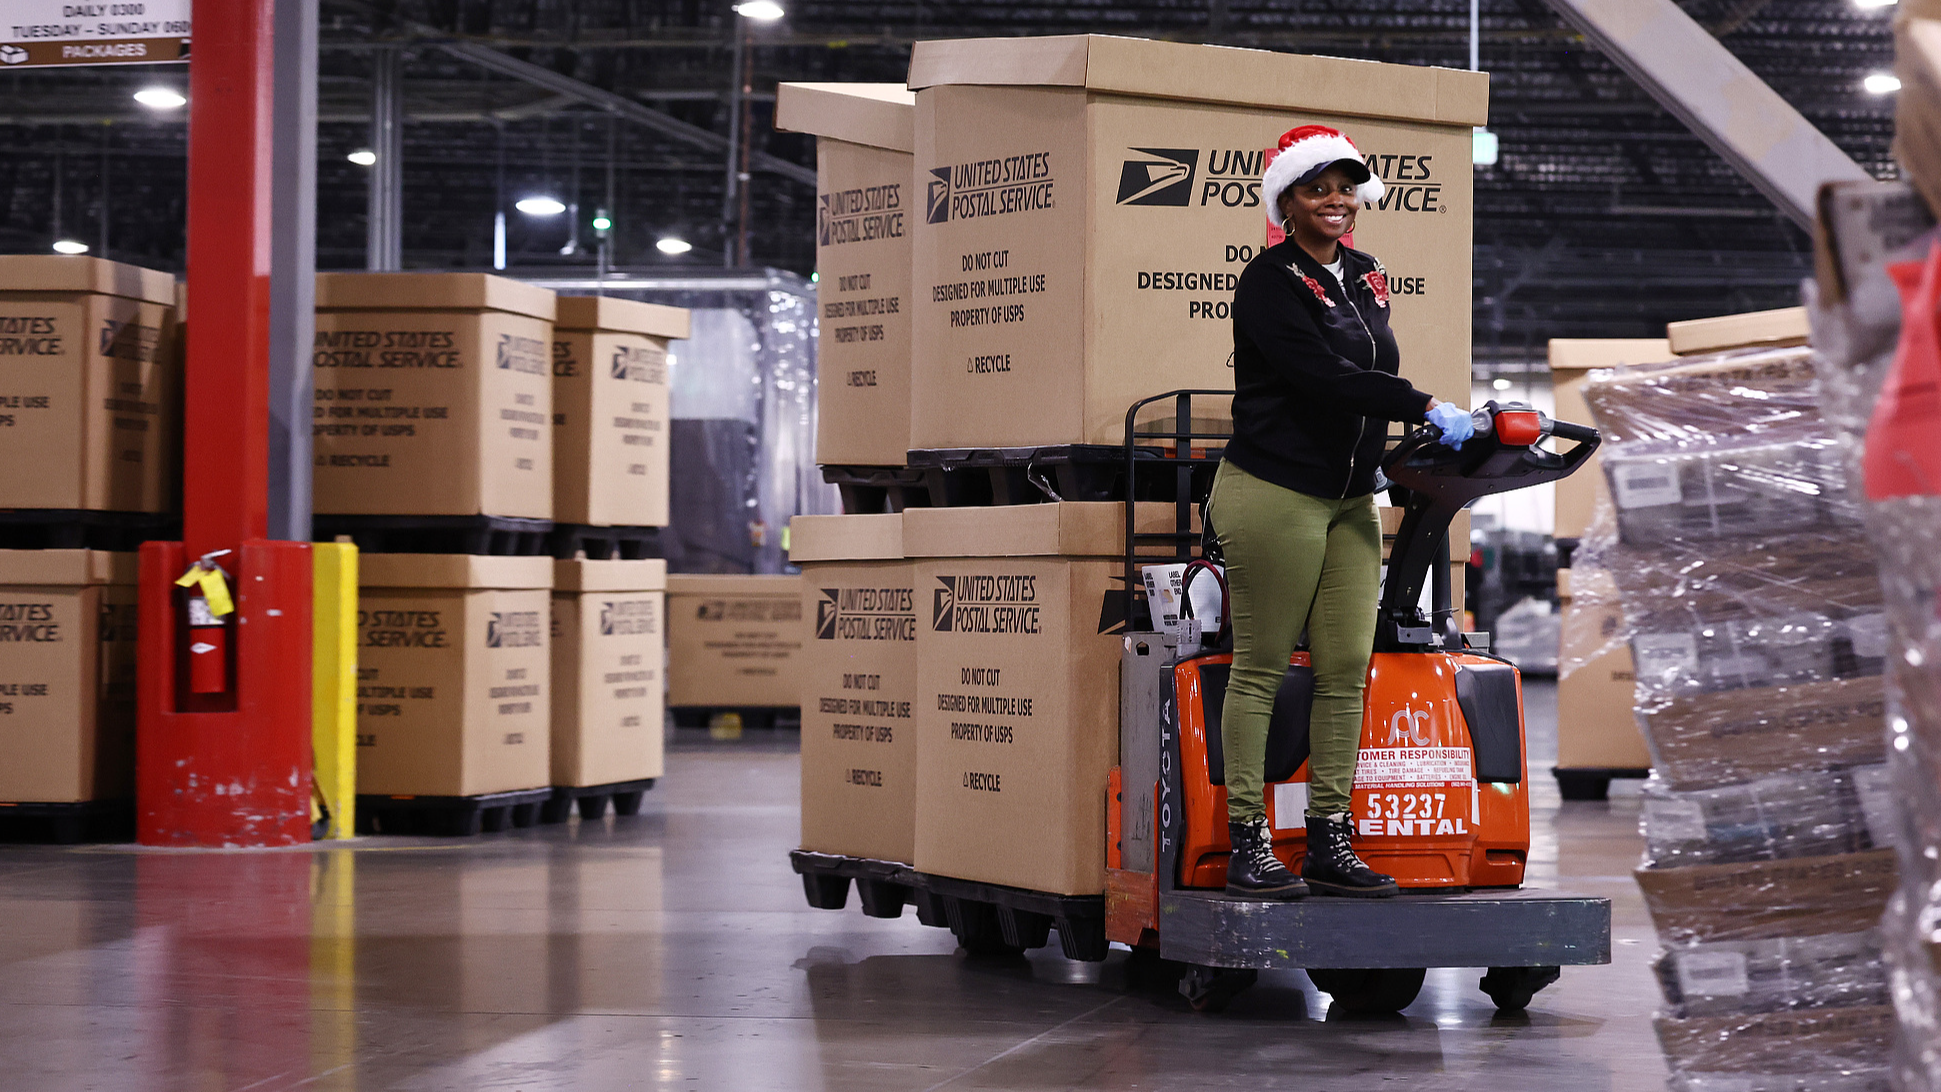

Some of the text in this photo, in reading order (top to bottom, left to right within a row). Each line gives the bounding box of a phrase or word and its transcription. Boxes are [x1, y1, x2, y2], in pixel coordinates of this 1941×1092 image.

[63, 3, 145, 17] DAILY 0300
[12, 24, 82, 37] TUESDAY
[97, 22, 160, 35] SUNDAY
[163, 21, 191, 33] 060
[62, 43, 147, 58] PACKAGES
[954, 152, 1050, 189] UNITED STATES
[1208, 149, 1432, 180] UNI ATES
[832, 184, 900, 217] UNITED STATES
[952, 183, 1054, 220] POSTAL SERVICE
[1201, 182, 1261, 207] POS
[832, 213, 904, 244] POSTAL SERVICE
[962, 250, 1009, 272] DO NOT CUT
[1225, 245, 1253, 263] DO
[933, 274, 1046, 302] DESIGNED FOR MULTIPLE USE
[1137, 271, 1426, 295] DESIGNED USE
[886, 297, 899, 313] USE
[1189, 301, 1234, 319] PRO
[951, 304, 1025, 327] PROPERTY OF USPS
[384, 331, 454, 348] STATES
[313, 351, 458, 368] OSTAL SERVICE
[975, 354, 1011, 373] RECYCLE
[23, 396, 50, 408] USE
[957, 575, 1036, 602] UNITED STATES
[840, 588, 913, 611] UNITED STATES
[371, 610, 440, 627] STATES
[955, 606, 1040, 634] POSTAL SERVICE
[366, 630, 446, 648] SERVICE
[838, 618, 916, 641] POSTAL SERVICE
[961, 668, 1000, 686] DO NOT CUT
[21, 684, 47, 696] USE
[862, 700, 895, 718] MULTIPLE
[896, 701, 911, 718] USE
[938, 694, 1033, 716] DESIGNED FOR MULTIPLE USE
[833, 723, 893, 743] PROPERTY OF USPS
[951, 722, 1013, 744] PROPERTY OF USPS
[1400, 749, 1469, 760] RESPONSIBILITY
[852, 769, 882, 787] RECYCLE
[970, 772, 1001, 792] RECYCLE
[1161, 698, 1172, 852] TOYOTA
[1374, 774, 1406, 782] EQUIPMENT
[1367, 793, 1446, 819] 53237
[1352, 818, 1468, 836] ENTAL
